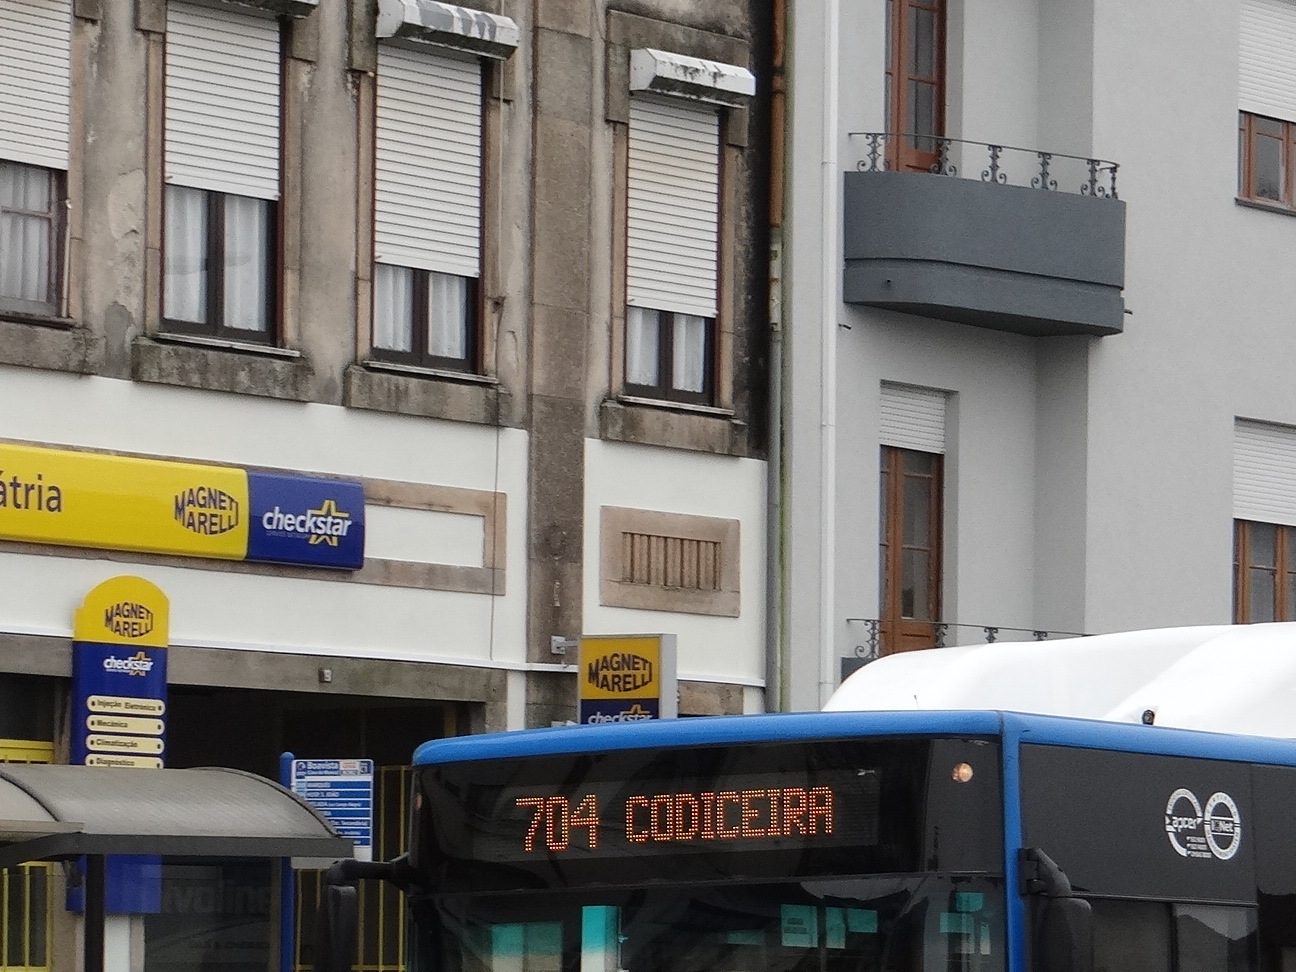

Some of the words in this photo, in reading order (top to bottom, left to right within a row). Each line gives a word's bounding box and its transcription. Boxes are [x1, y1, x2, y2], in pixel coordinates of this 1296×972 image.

[262, 506, 352, 536] checkstar
[103, 655, 154, 671] checkstar
[515, 794, 599, 851] 704
[625, 786, 834, 843] CODICEIRA
